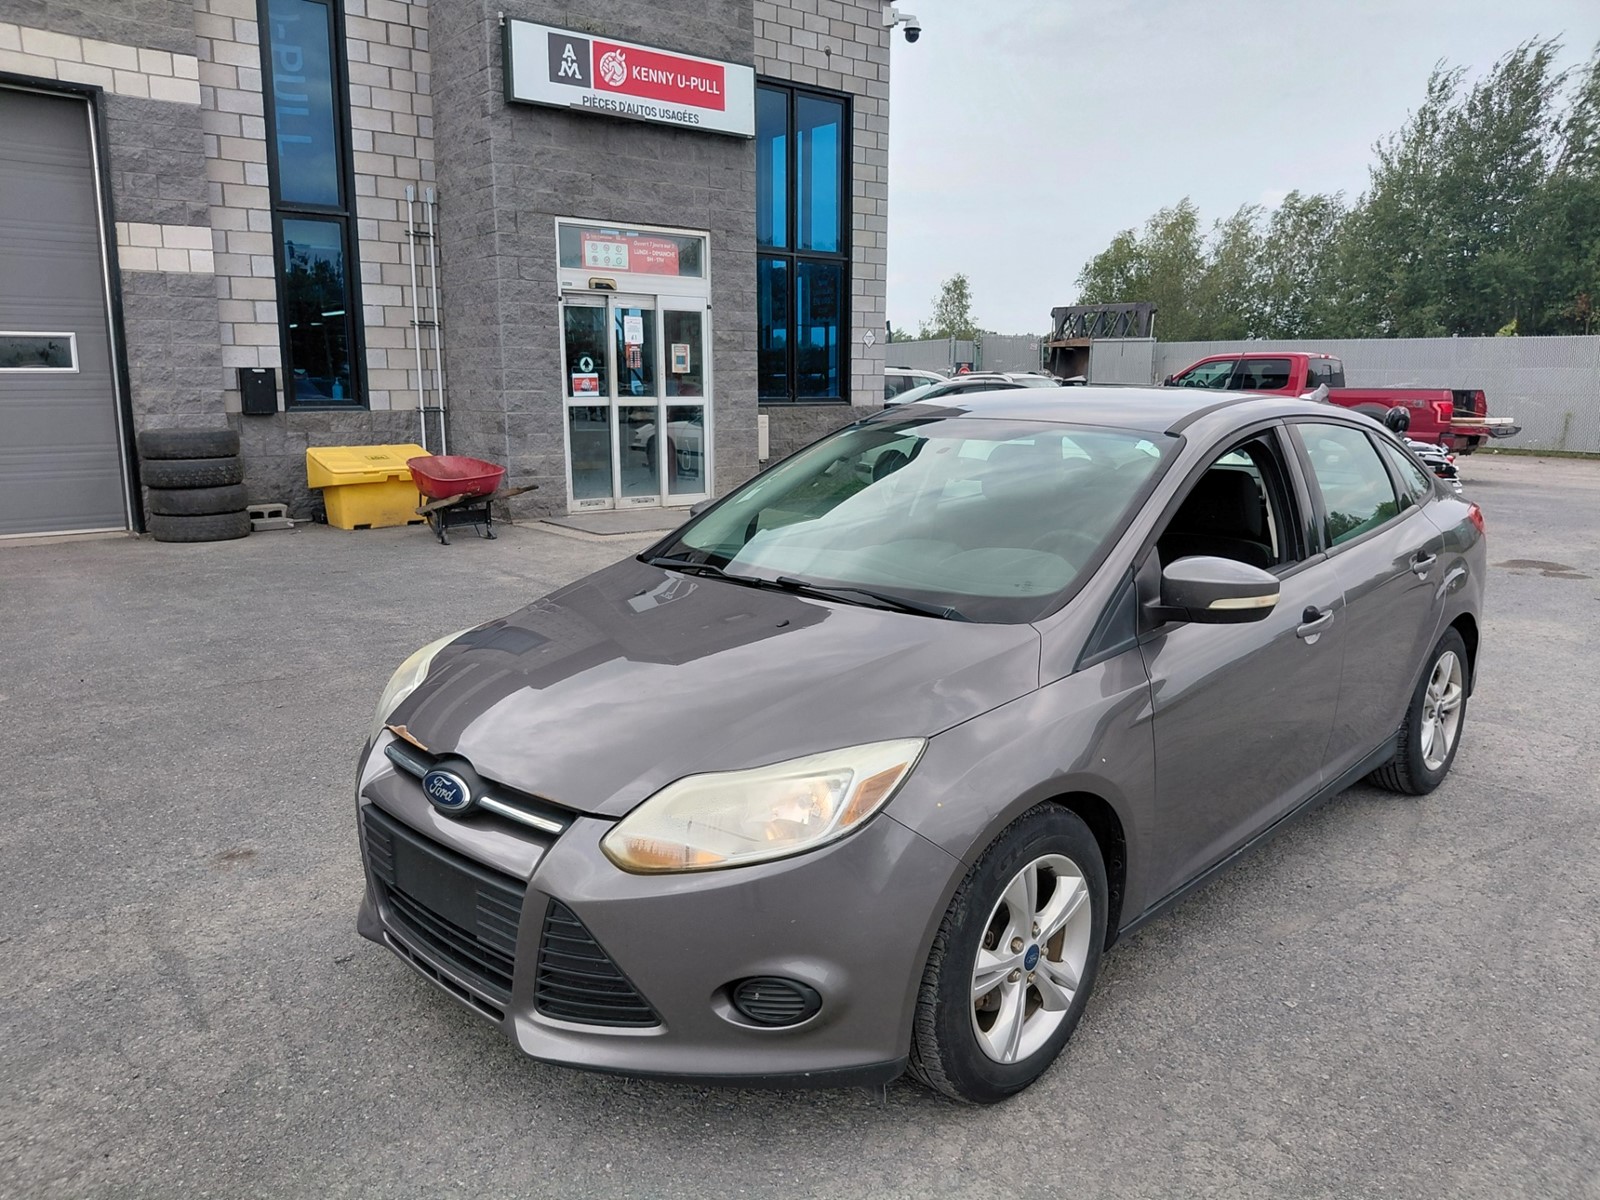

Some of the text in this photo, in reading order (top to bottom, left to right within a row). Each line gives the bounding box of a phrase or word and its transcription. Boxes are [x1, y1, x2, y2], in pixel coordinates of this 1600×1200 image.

[632, 65, 720, 95] KENNY U-PULL
[582, 94, 700, 124] PIÈCES D'AUTOS USAGÉES
[429, 776, 457, 802] Ford
